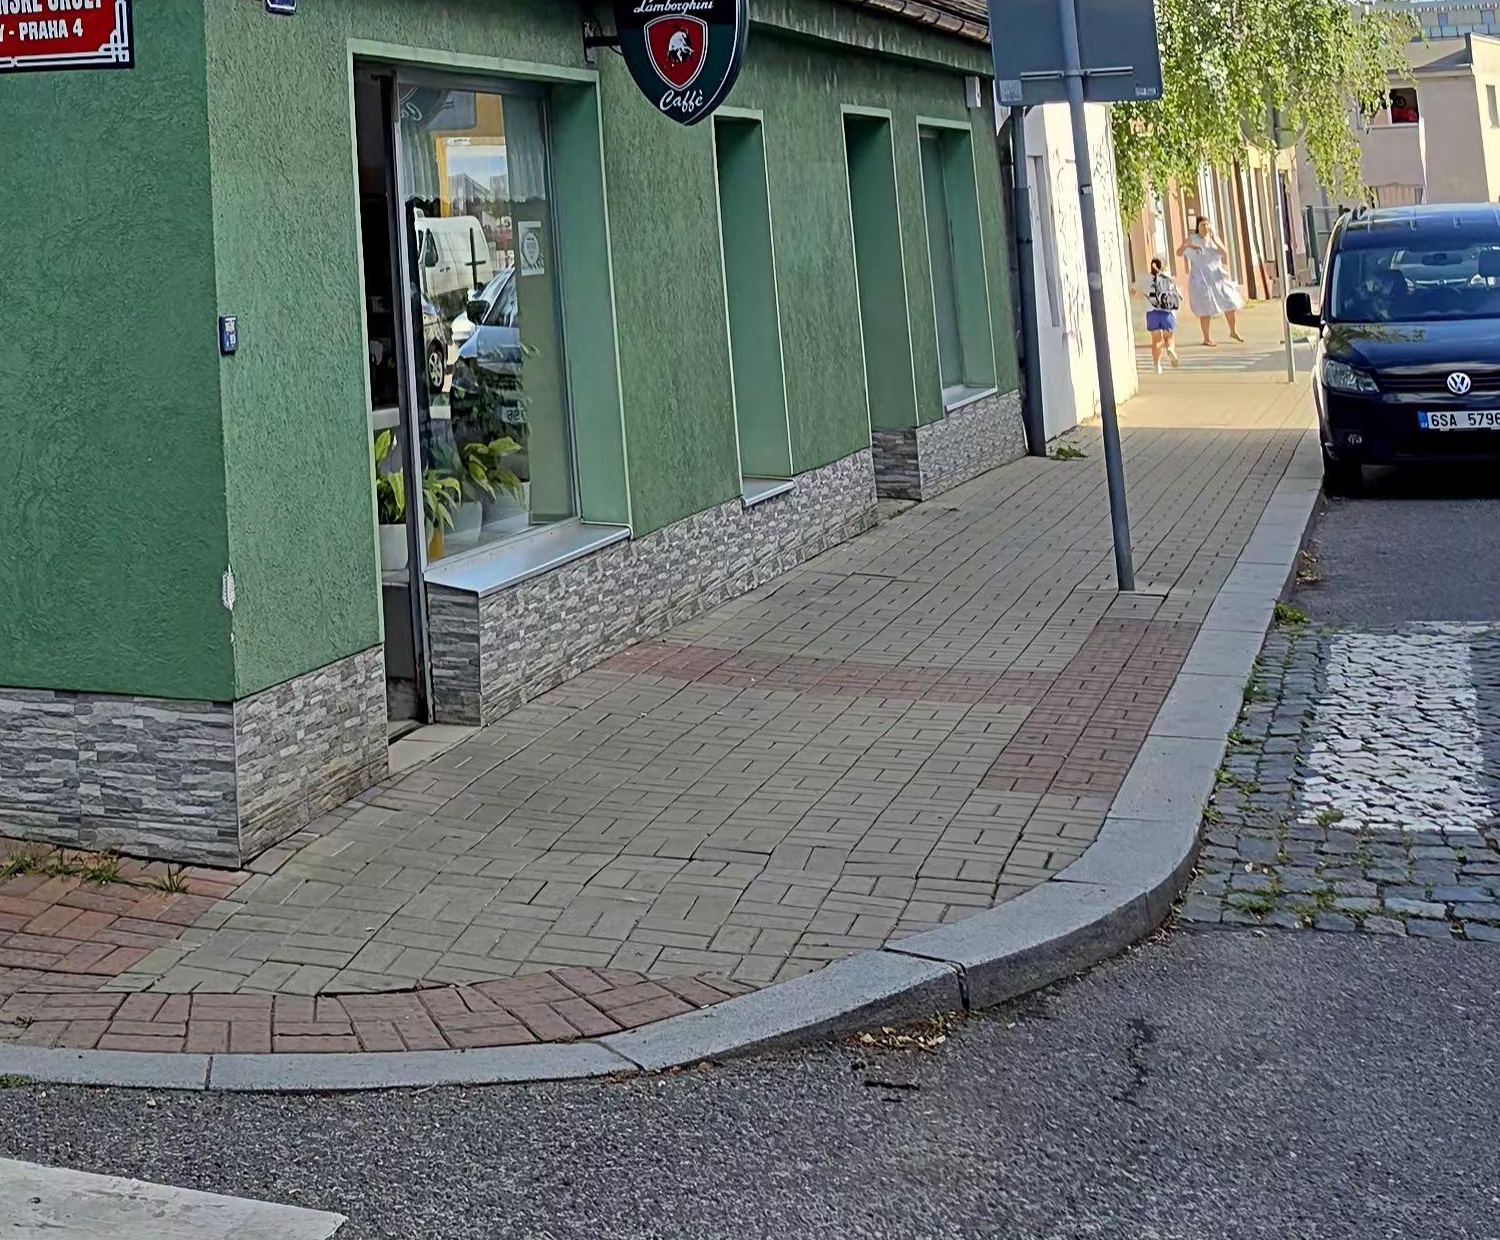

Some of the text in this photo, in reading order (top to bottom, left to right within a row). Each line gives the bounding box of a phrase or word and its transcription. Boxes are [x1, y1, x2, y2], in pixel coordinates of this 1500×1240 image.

[18, 19, 69, 41] PRAHA
[72, 17, 84, 37] 4
[660, 89, 704, 112] Caffè
[1430, 414, 1458, 427] 6SA
